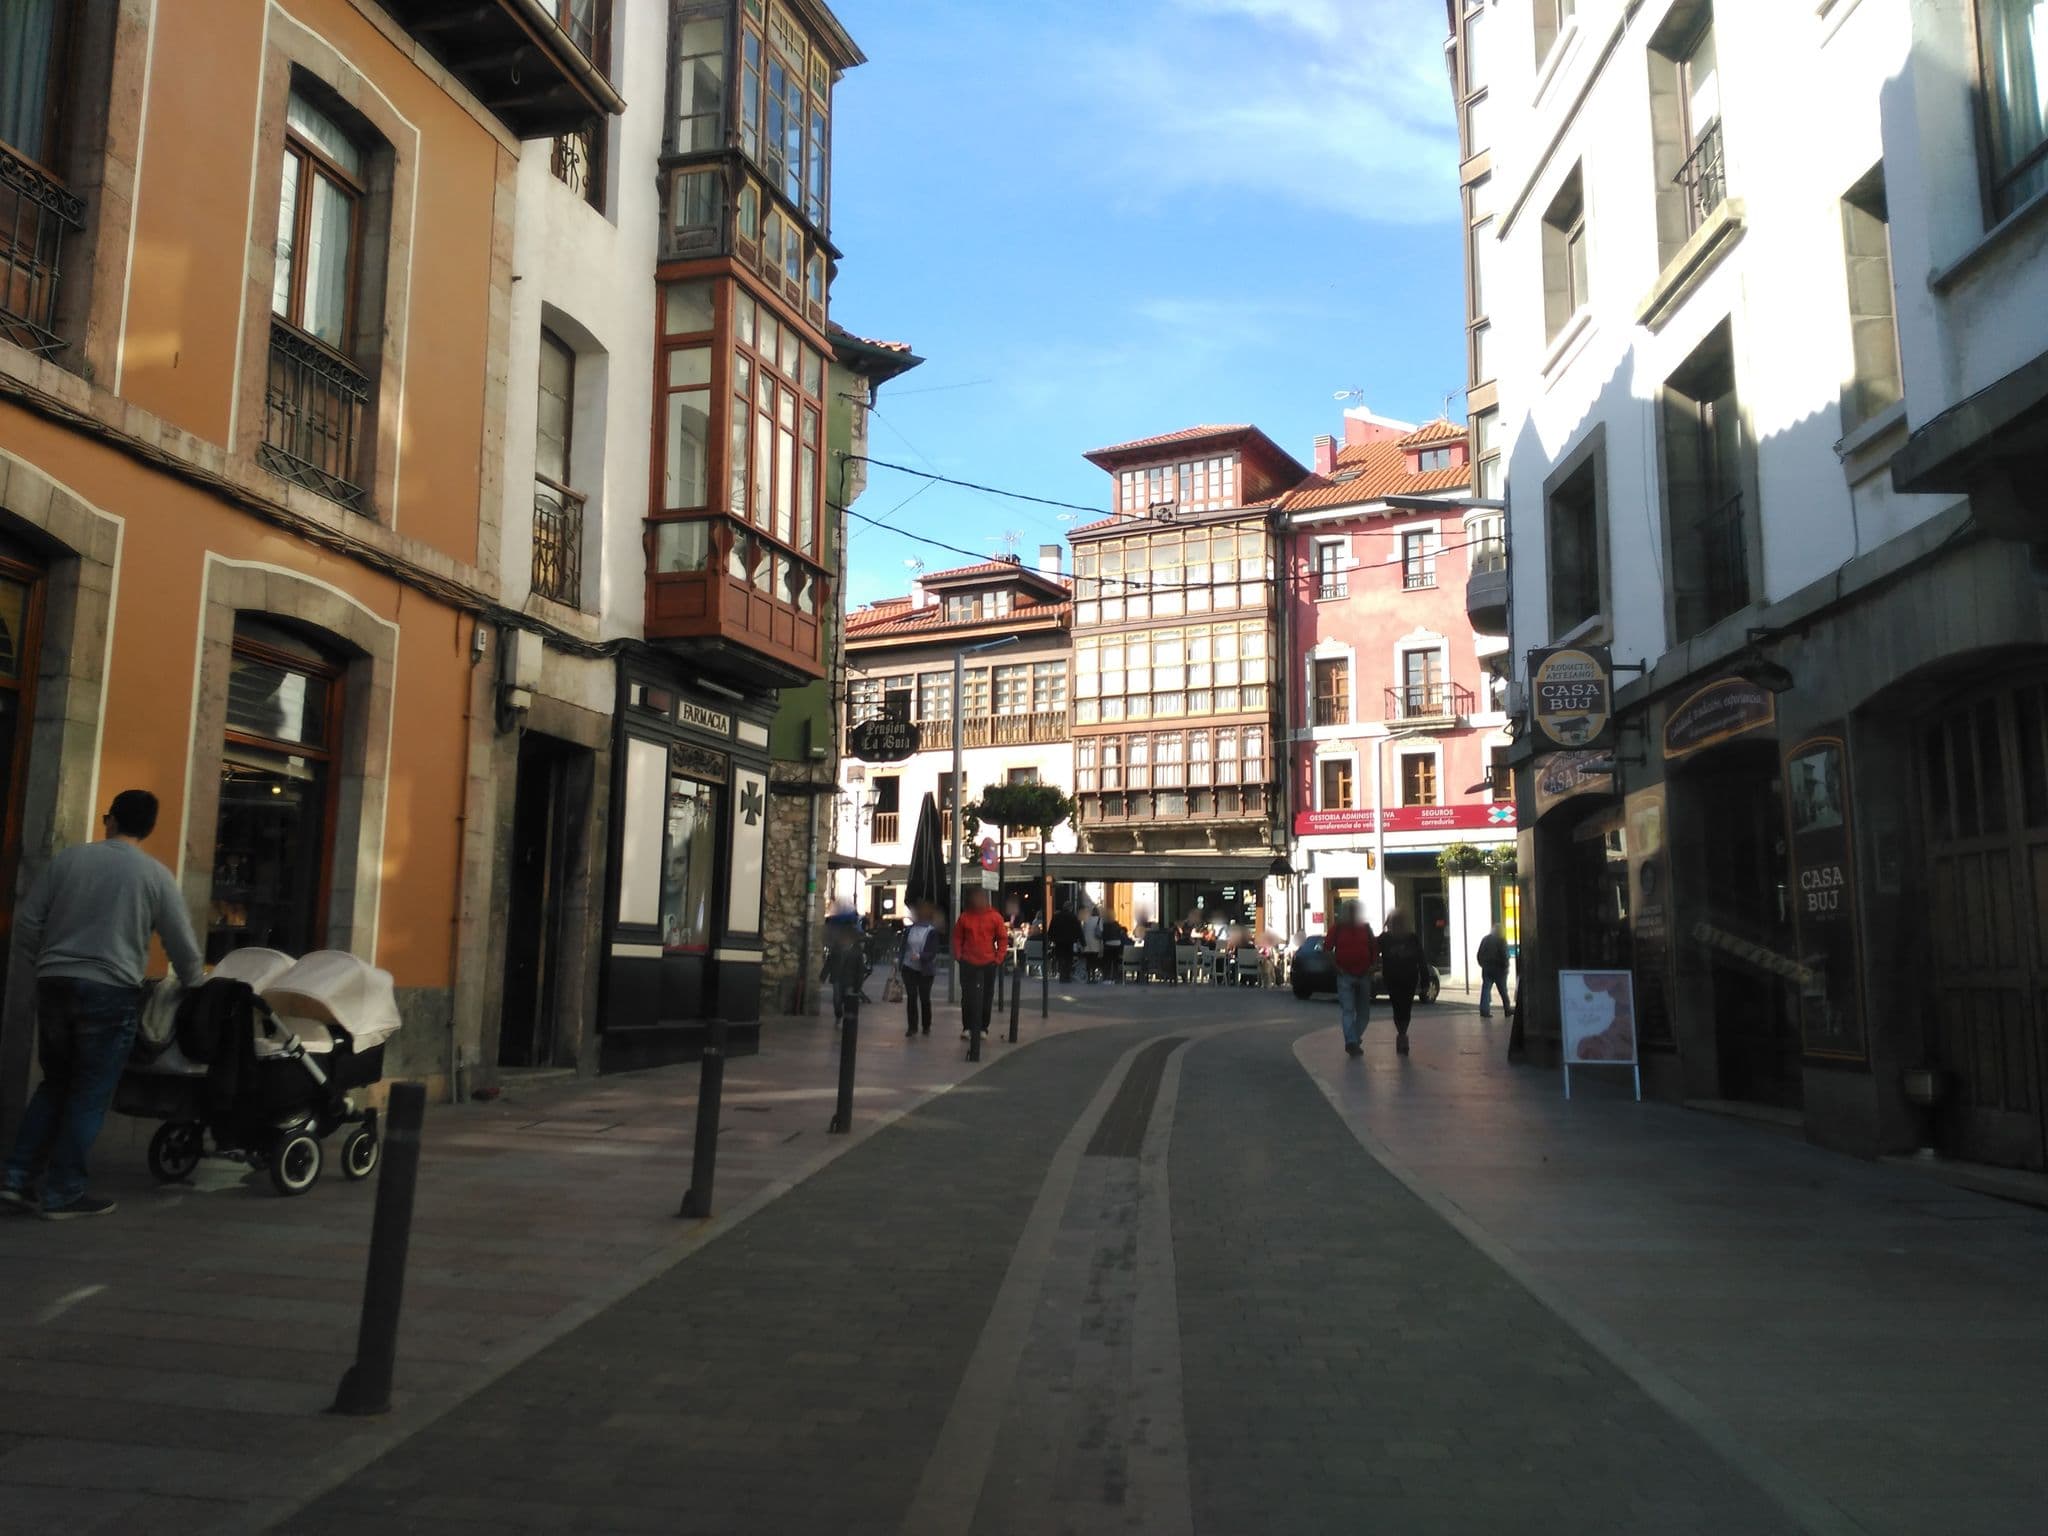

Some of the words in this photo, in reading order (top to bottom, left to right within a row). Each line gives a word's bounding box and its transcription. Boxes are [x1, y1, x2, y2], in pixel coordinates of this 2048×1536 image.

[1545, 662, 1595, 672] PRODUCTOS
[1546, 671, 1595, 680] ARTESANOS
[1541, 684, 1600, 697] CASA
[1550, 697, 1592, 710] BUJ
[683, 703, 727, 732] FARMACIA
[1542, 769, 1574, 797] CASA
[1421, 808, 1454, 817] SEGUROS
[1801, 866, 1844, 889] CASA
[1807, 890, 1839, 912] BUJ
